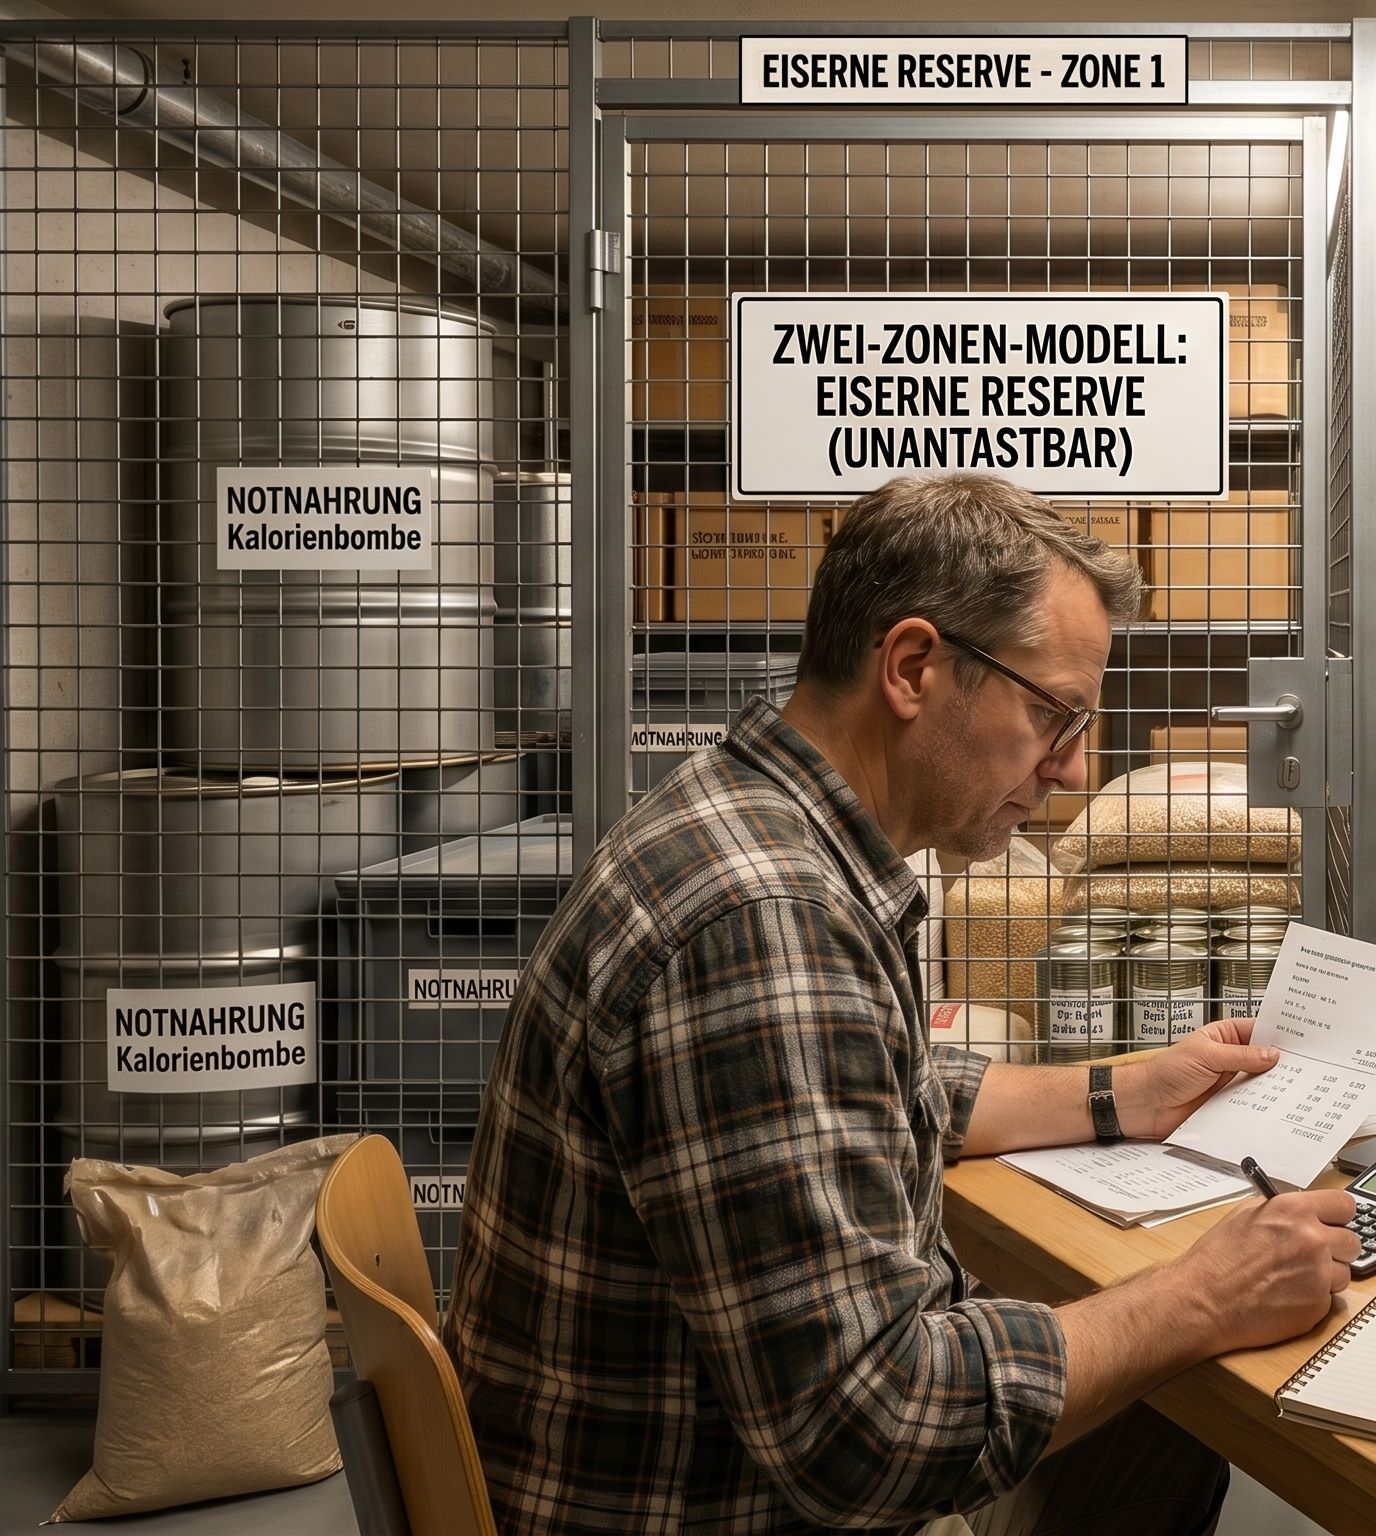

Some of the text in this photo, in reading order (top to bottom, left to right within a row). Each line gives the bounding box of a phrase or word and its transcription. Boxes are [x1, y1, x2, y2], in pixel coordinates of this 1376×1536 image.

[762, 54, 889, 88] EISERNE
[898, 54, 1031, 88] RESERVE
[1061, 54, 1141, 88] ZONE
[1150, 54, 1165, 88] 1
[773, 323, 1187, 365] ZWEI-ZONEN-MODELL:
[816, 375, 1146, 417] EISERNE RESERVE
[827, 427, 1134, 475] (UNANTASTBAR)
[227, 486, 422, 515] NOTNAHRUNG
[227, 523, 422, 551] Kalorienbombe
[115, 1002, 305, 1038] NOTNAHRUNG
[116, 1041, 306, 1073] Kalorienbombe
